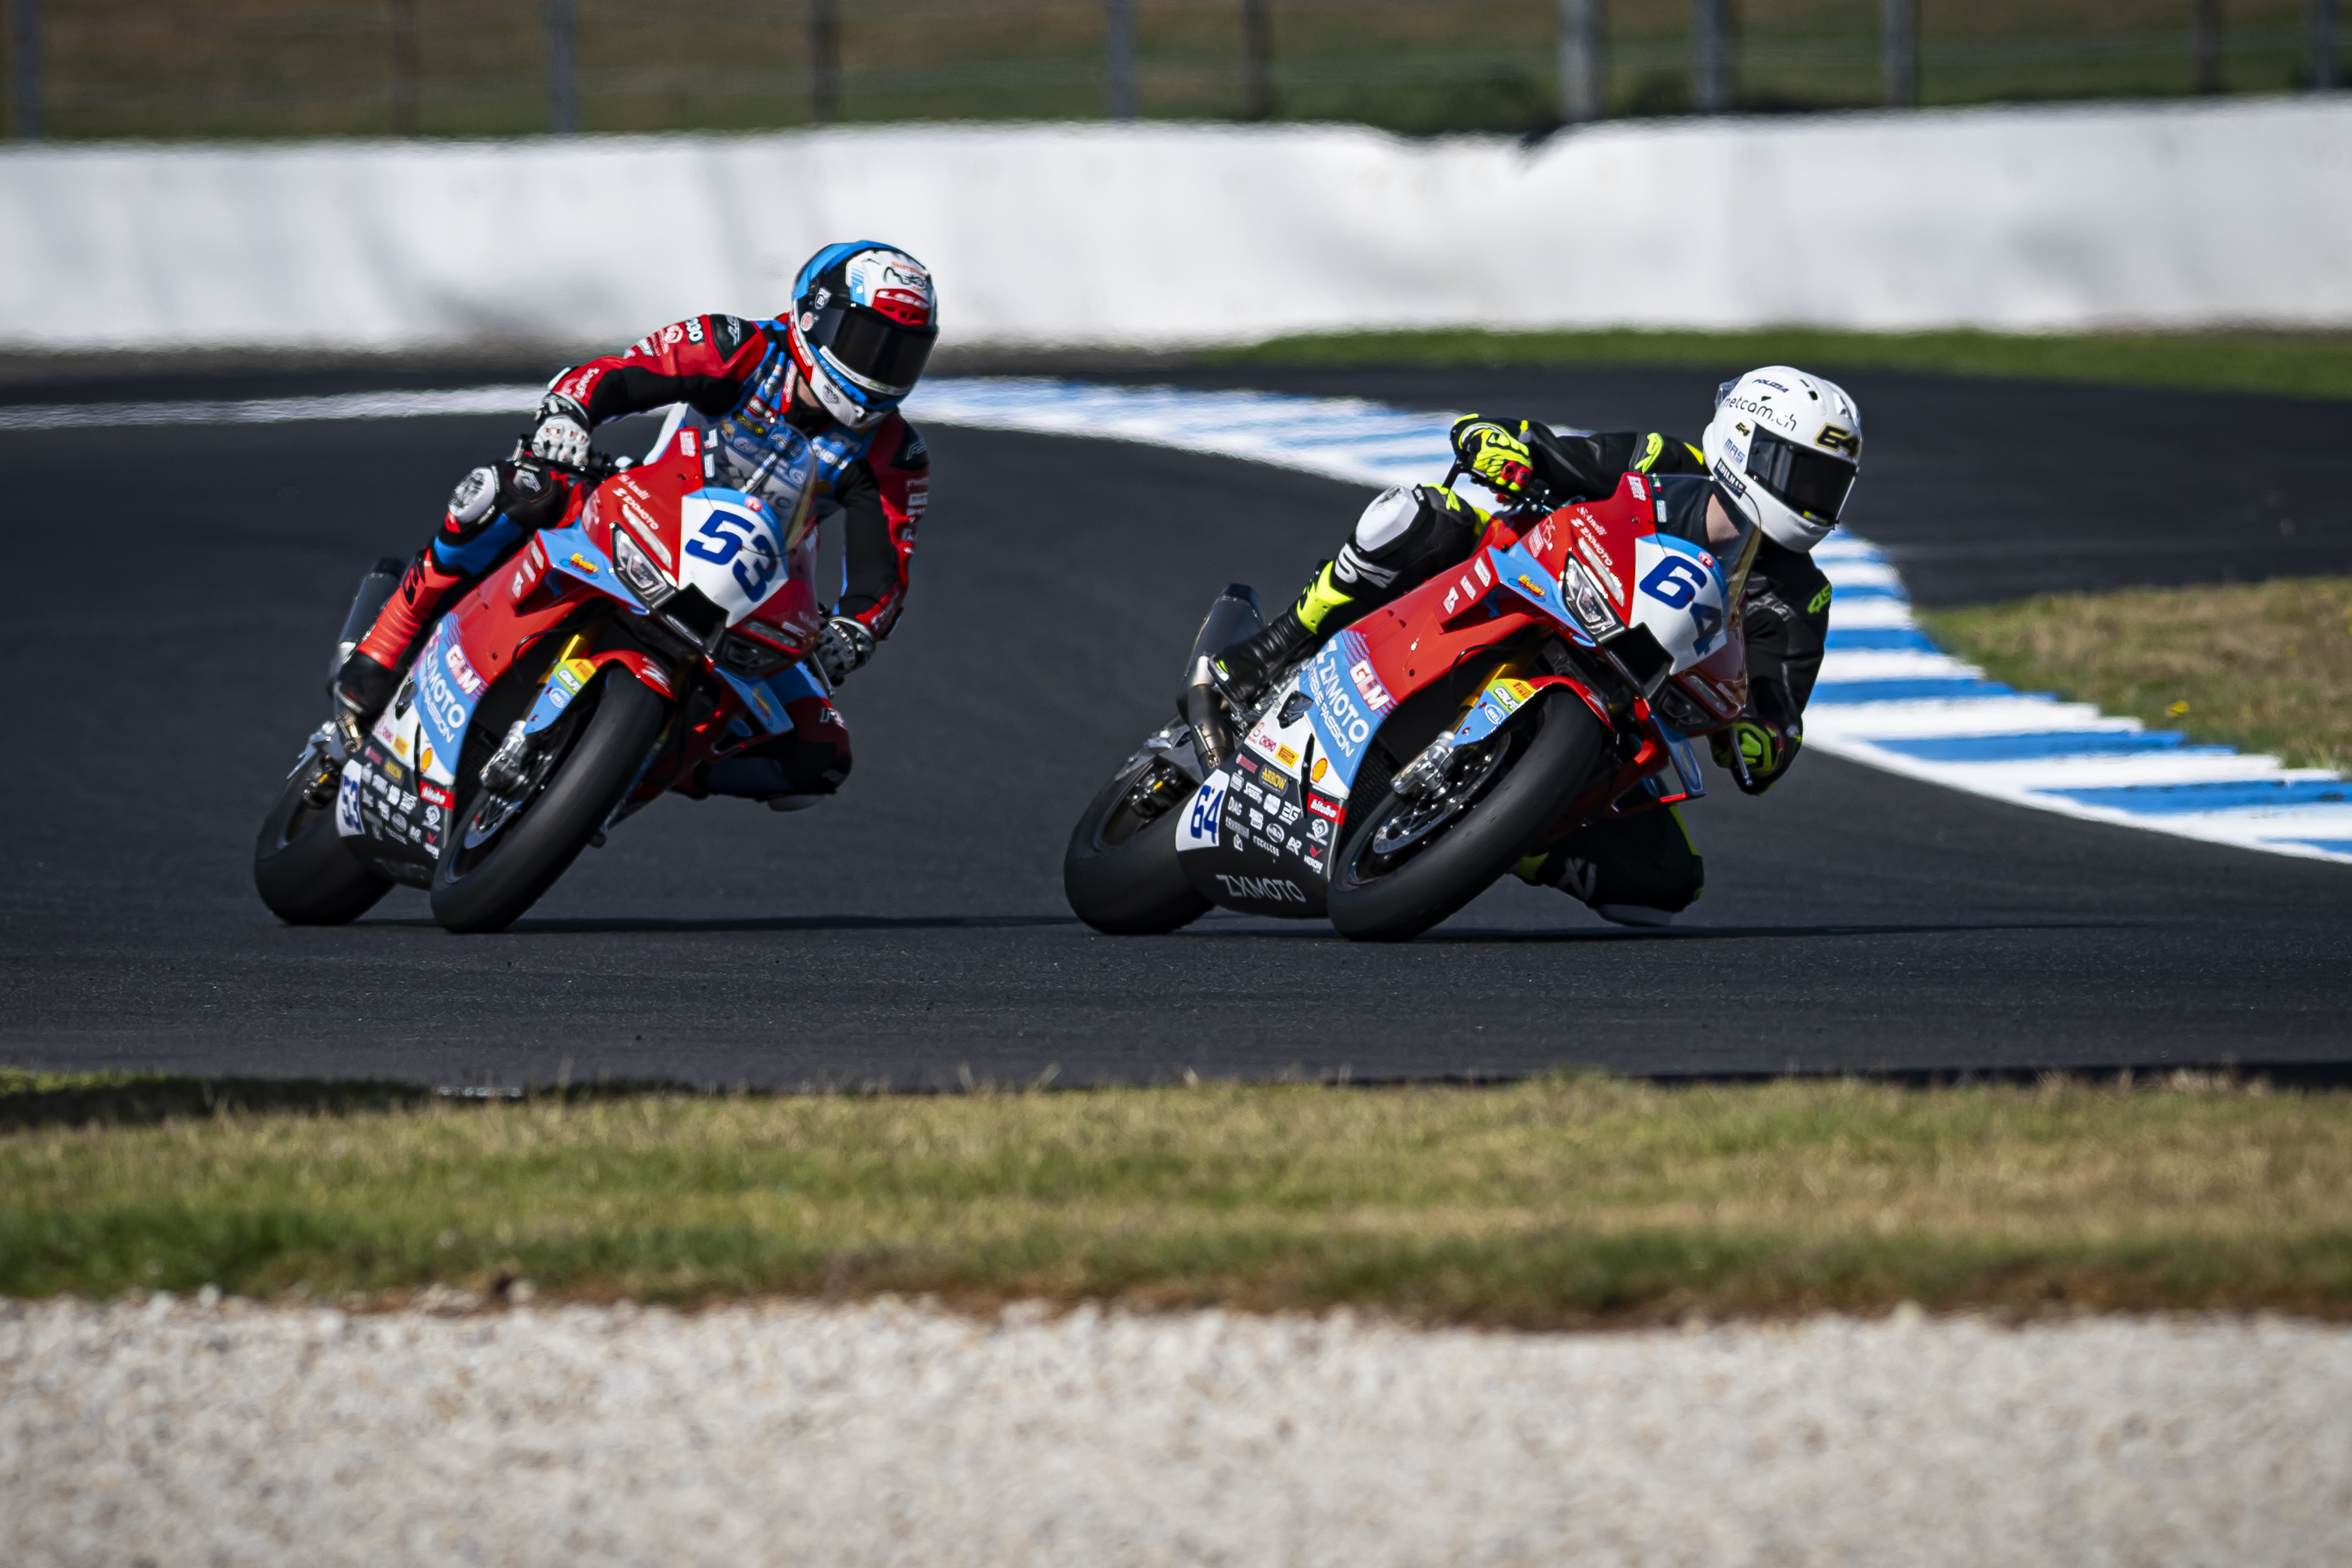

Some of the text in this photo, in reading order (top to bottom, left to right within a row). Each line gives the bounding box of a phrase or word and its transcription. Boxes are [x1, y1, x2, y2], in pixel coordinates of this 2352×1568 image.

[1722, 396, 1797, 432] netcam.ch
[1814, 422, 1860, 458] 64
[685, 509, 779, 603] 53
[1580, 527, 1613, 566] ZXMOTO
[1639, 556, 1722, 657] 64
[1319, 657, 1370, 744] ZXMOTO
[1321, 703, 1355, 758] PASSION
[1190, 784, 1225, 845] 64
[1310, 798, 1337, 818] bitubo
[1215, 874, 1307, 902] ZXMOTO
